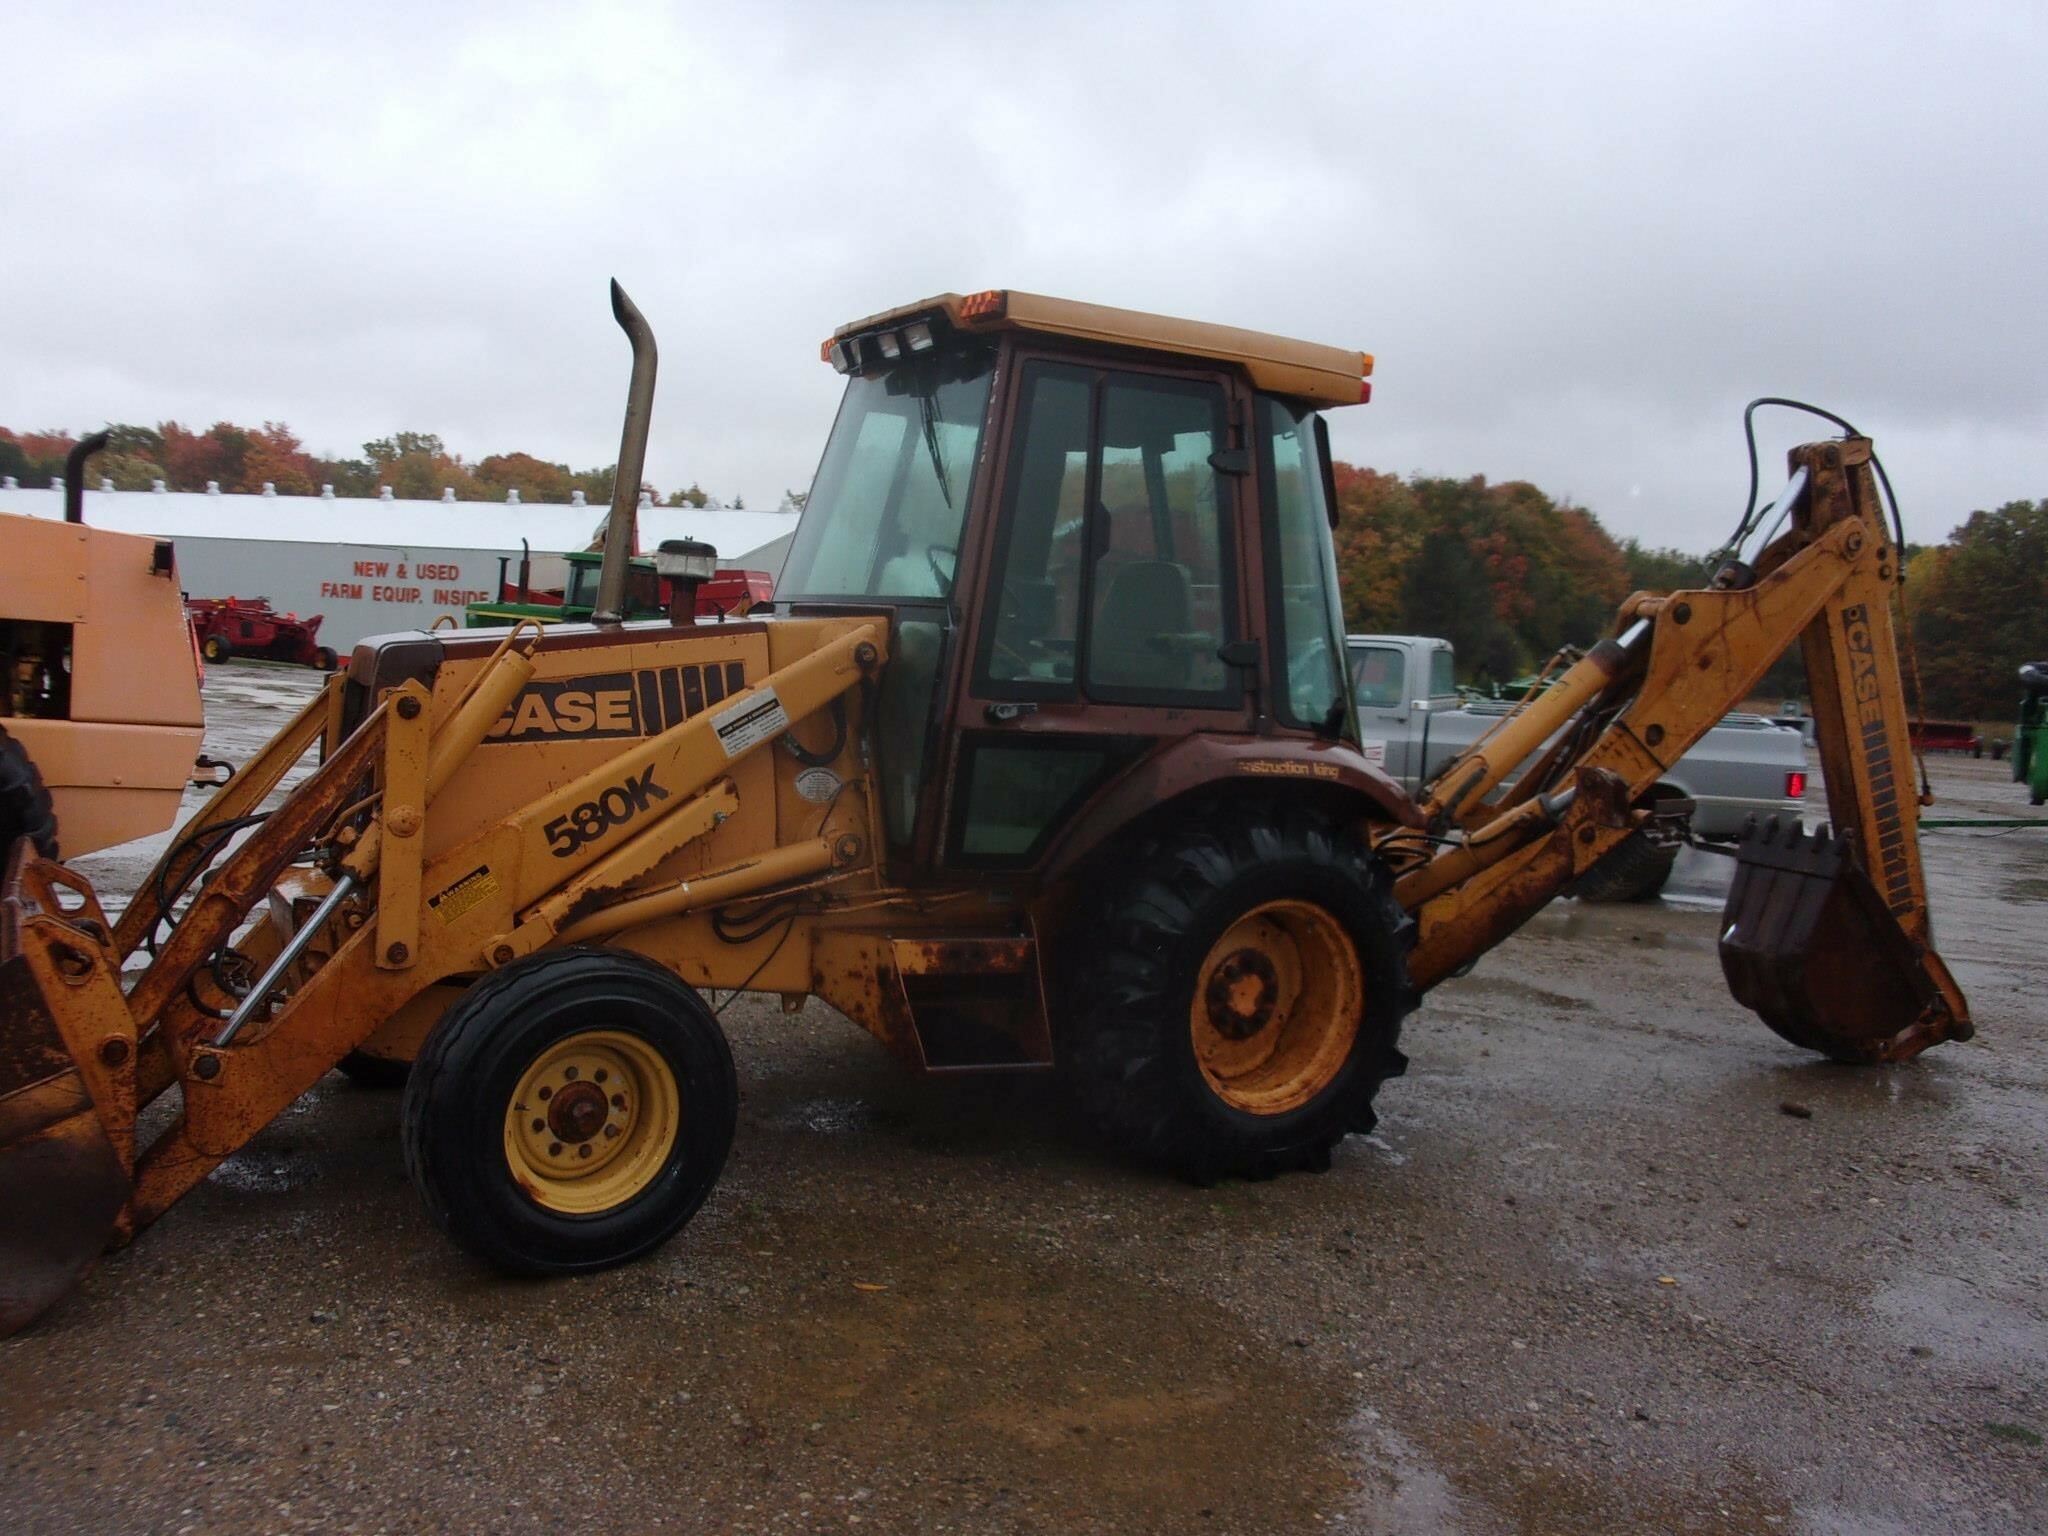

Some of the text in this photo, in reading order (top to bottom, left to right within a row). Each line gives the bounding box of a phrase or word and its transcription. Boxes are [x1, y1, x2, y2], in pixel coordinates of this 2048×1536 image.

[321, 582, 363, 599] FARM
[372, 585, 423, 604] EQUIP.
[354, 561, 459, 581] NEW & USED
[1848, 621, 1884, 724] CASE
[543, 762, 669, 858] 580K
